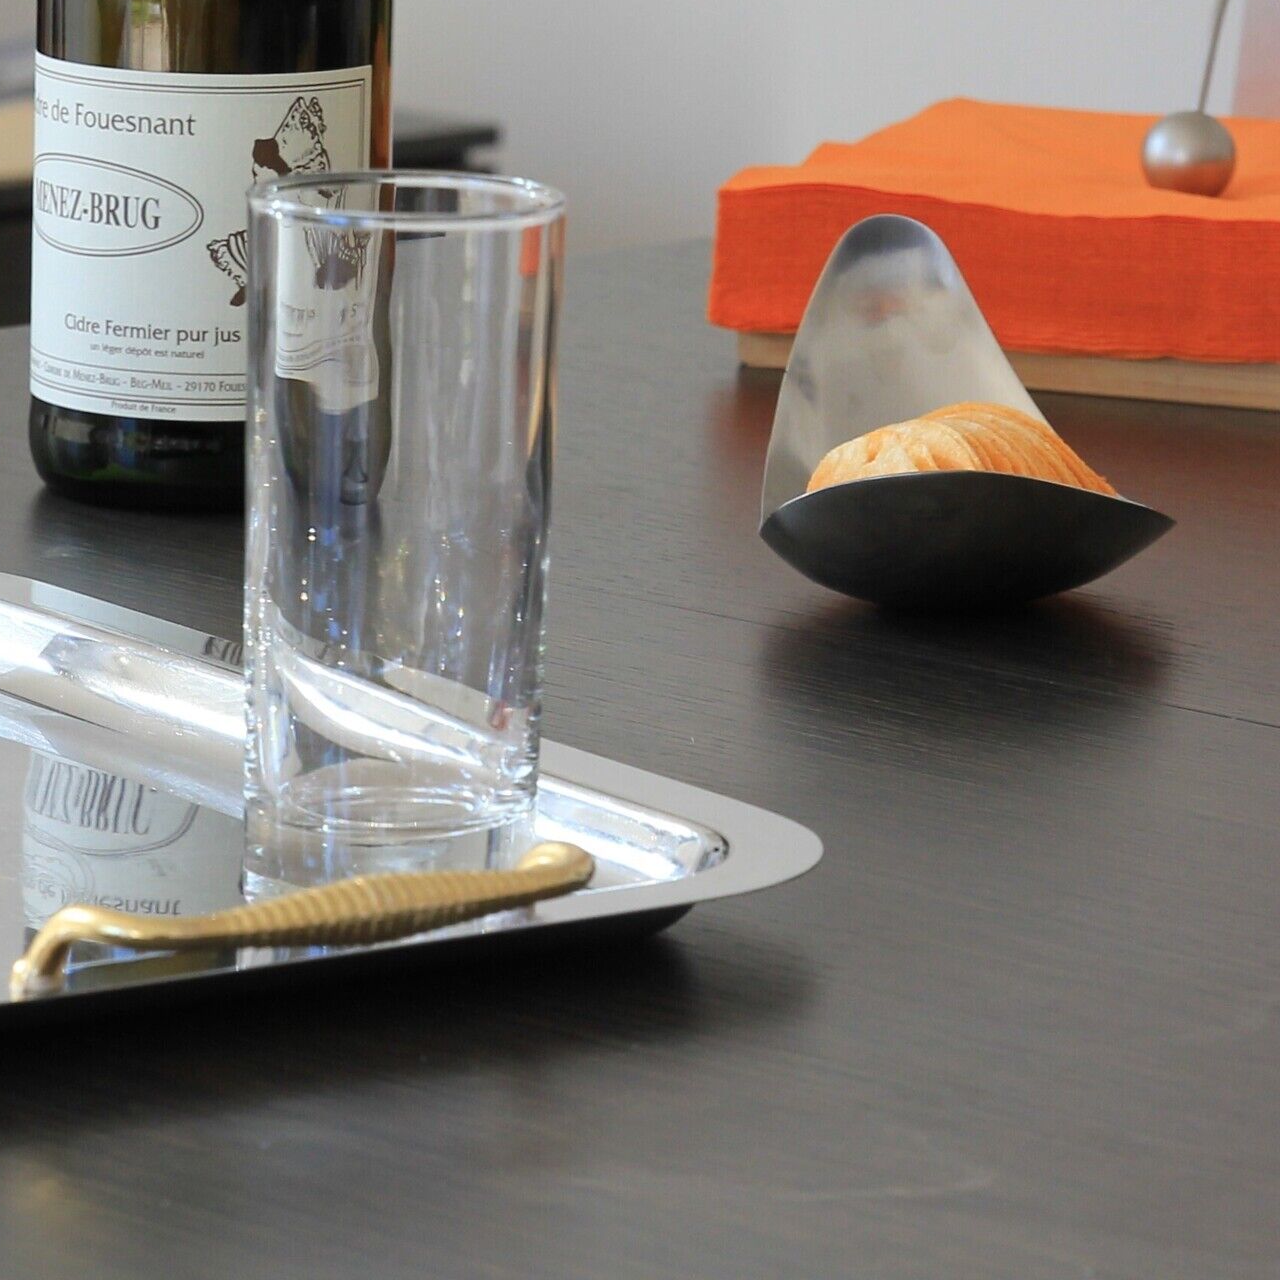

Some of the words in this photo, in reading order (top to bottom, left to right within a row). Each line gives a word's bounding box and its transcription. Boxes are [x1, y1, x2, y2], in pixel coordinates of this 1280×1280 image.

[51, 99, 69, 124] de
[75, 102, 196, 137] Fouesnant
[64, 313, 101, 334] Cidre
[104, 320, 171, 341] Fermier
[176, 328, 208, 345] pur
[214, 326, 242, 347] jus
[154, 348, 169, 358] est
[170, 349, 205, 360] naturel
[184, 380, 216, 393] 29170
[111, 400, 137, 413] Produit
[139, 403, 150, 413] de
[151, 403, 176, 414] France
